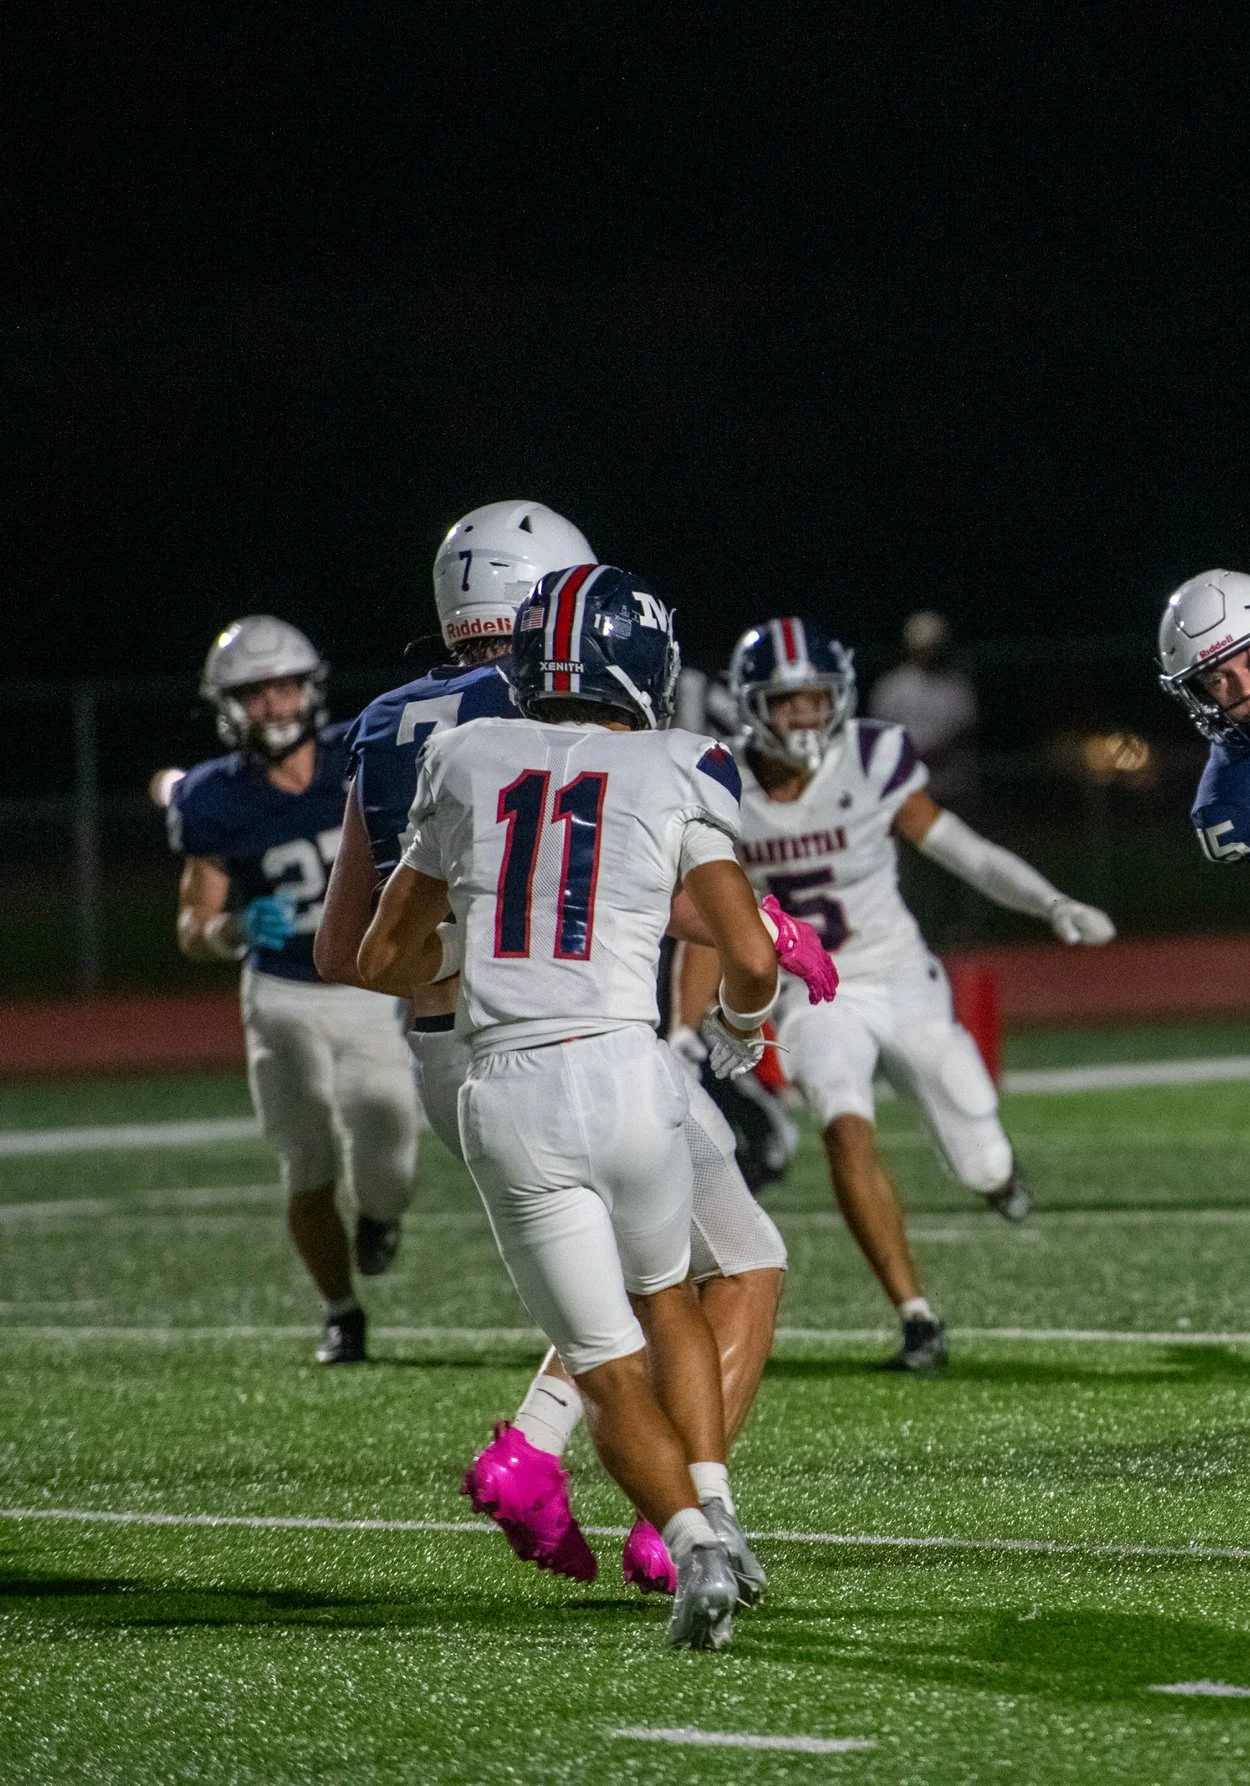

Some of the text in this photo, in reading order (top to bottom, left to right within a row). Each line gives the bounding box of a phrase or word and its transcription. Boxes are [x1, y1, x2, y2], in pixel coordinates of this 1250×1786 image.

[458, 550, 473, 588] 7
[446, 617, 512, 639] Riddell
[1199, 634, 1234, 659] Riddell
[539, 661, 585, 673] XENITH
[494, 768, 609, 961] 11
[765, 864, 851, 955] 5
